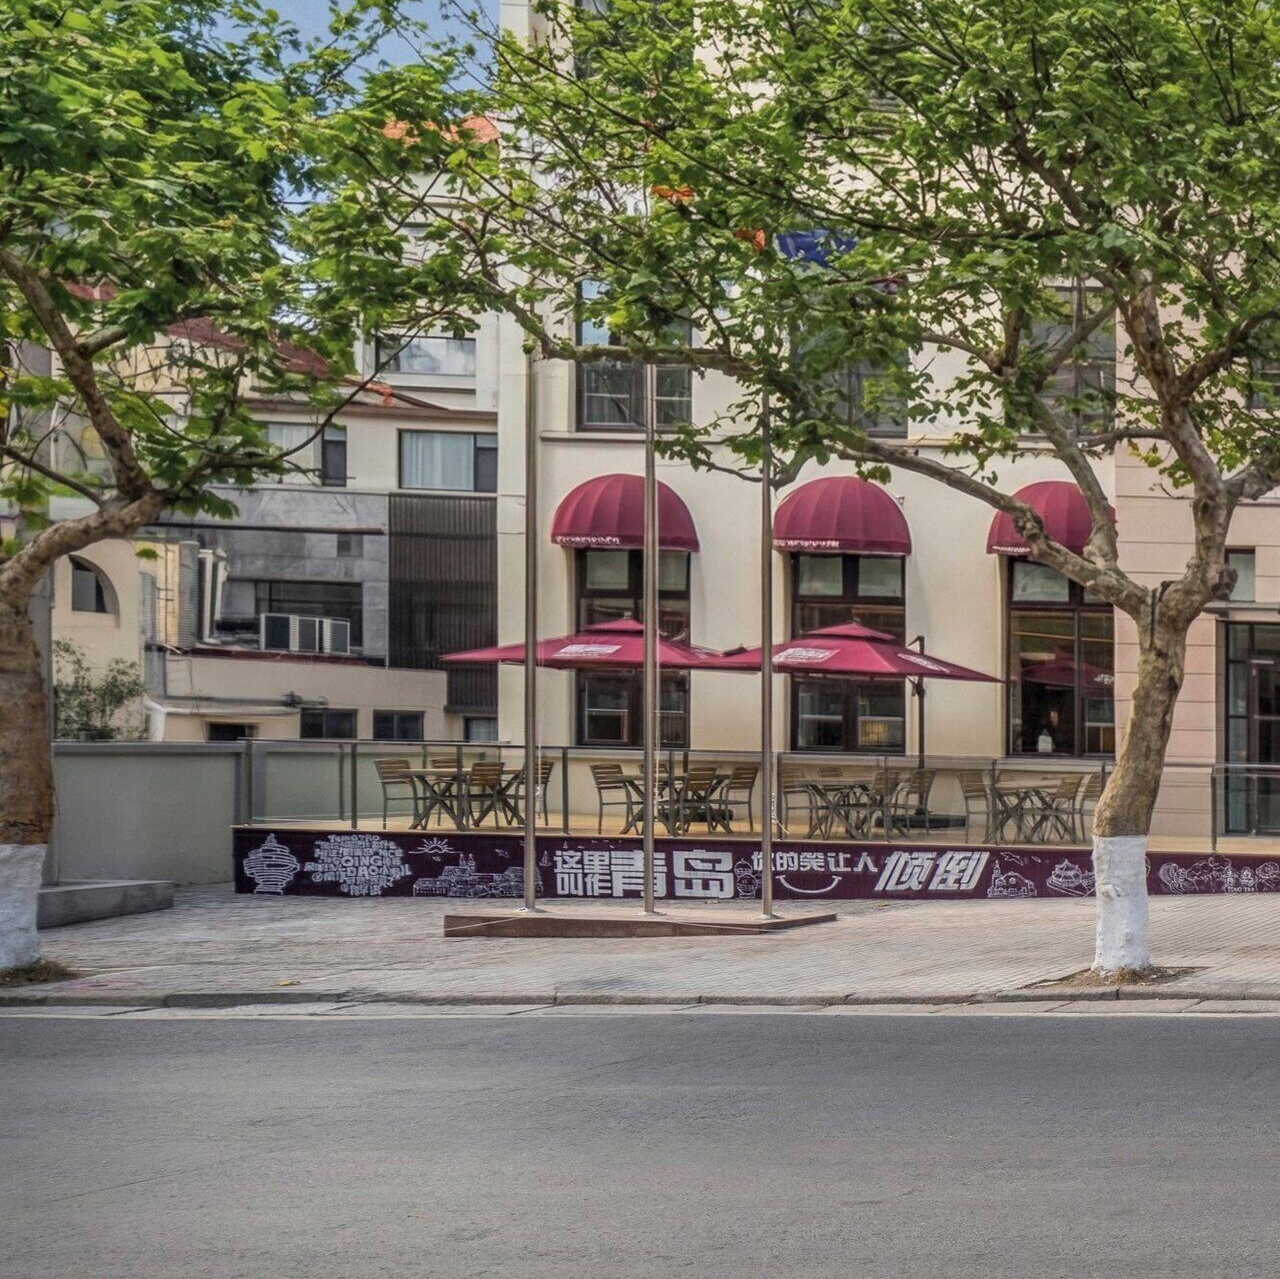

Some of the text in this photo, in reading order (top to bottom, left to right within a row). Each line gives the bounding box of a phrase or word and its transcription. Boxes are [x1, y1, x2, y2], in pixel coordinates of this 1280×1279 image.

[554, 850, 610, 873] 这里
[610, 850, 734, 898] 青岛
[874, 851, 990, 891] 倾倒
[556, 873, 611, 897] 叫作
